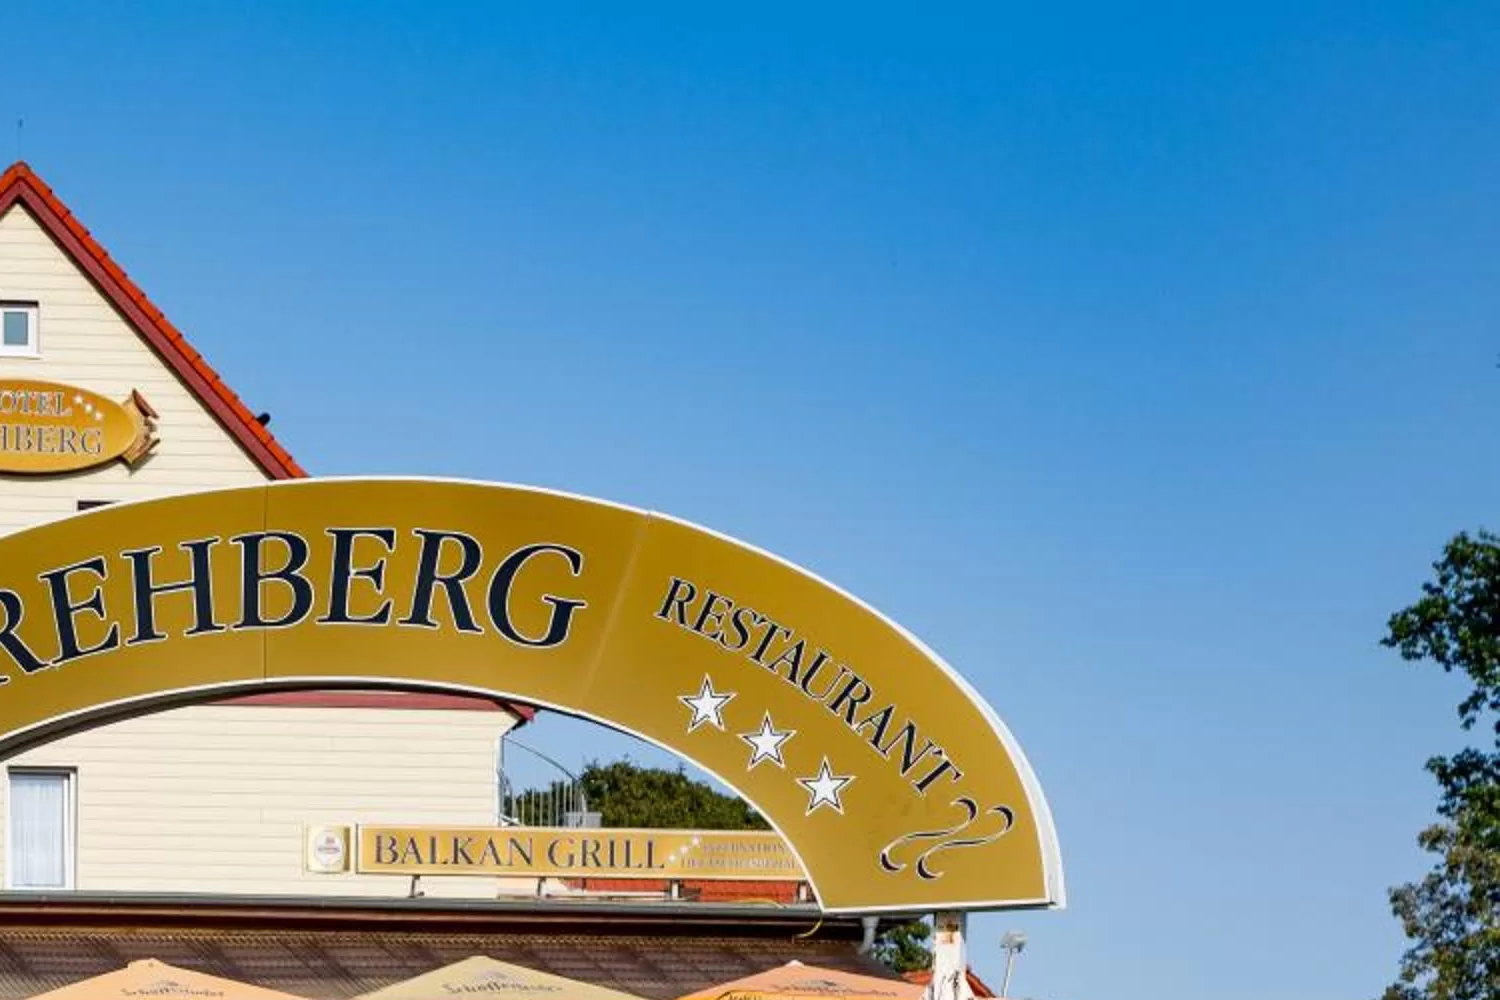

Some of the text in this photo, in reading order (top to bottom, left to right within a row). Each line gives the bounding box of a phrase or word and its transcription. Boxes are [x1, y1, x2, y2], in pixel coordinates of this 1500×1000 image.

[654, 576, 964, 798] RESTAURANT
[374, 834, 534, 866] BALKAN
[547, 837, 665, 869] GRILL
